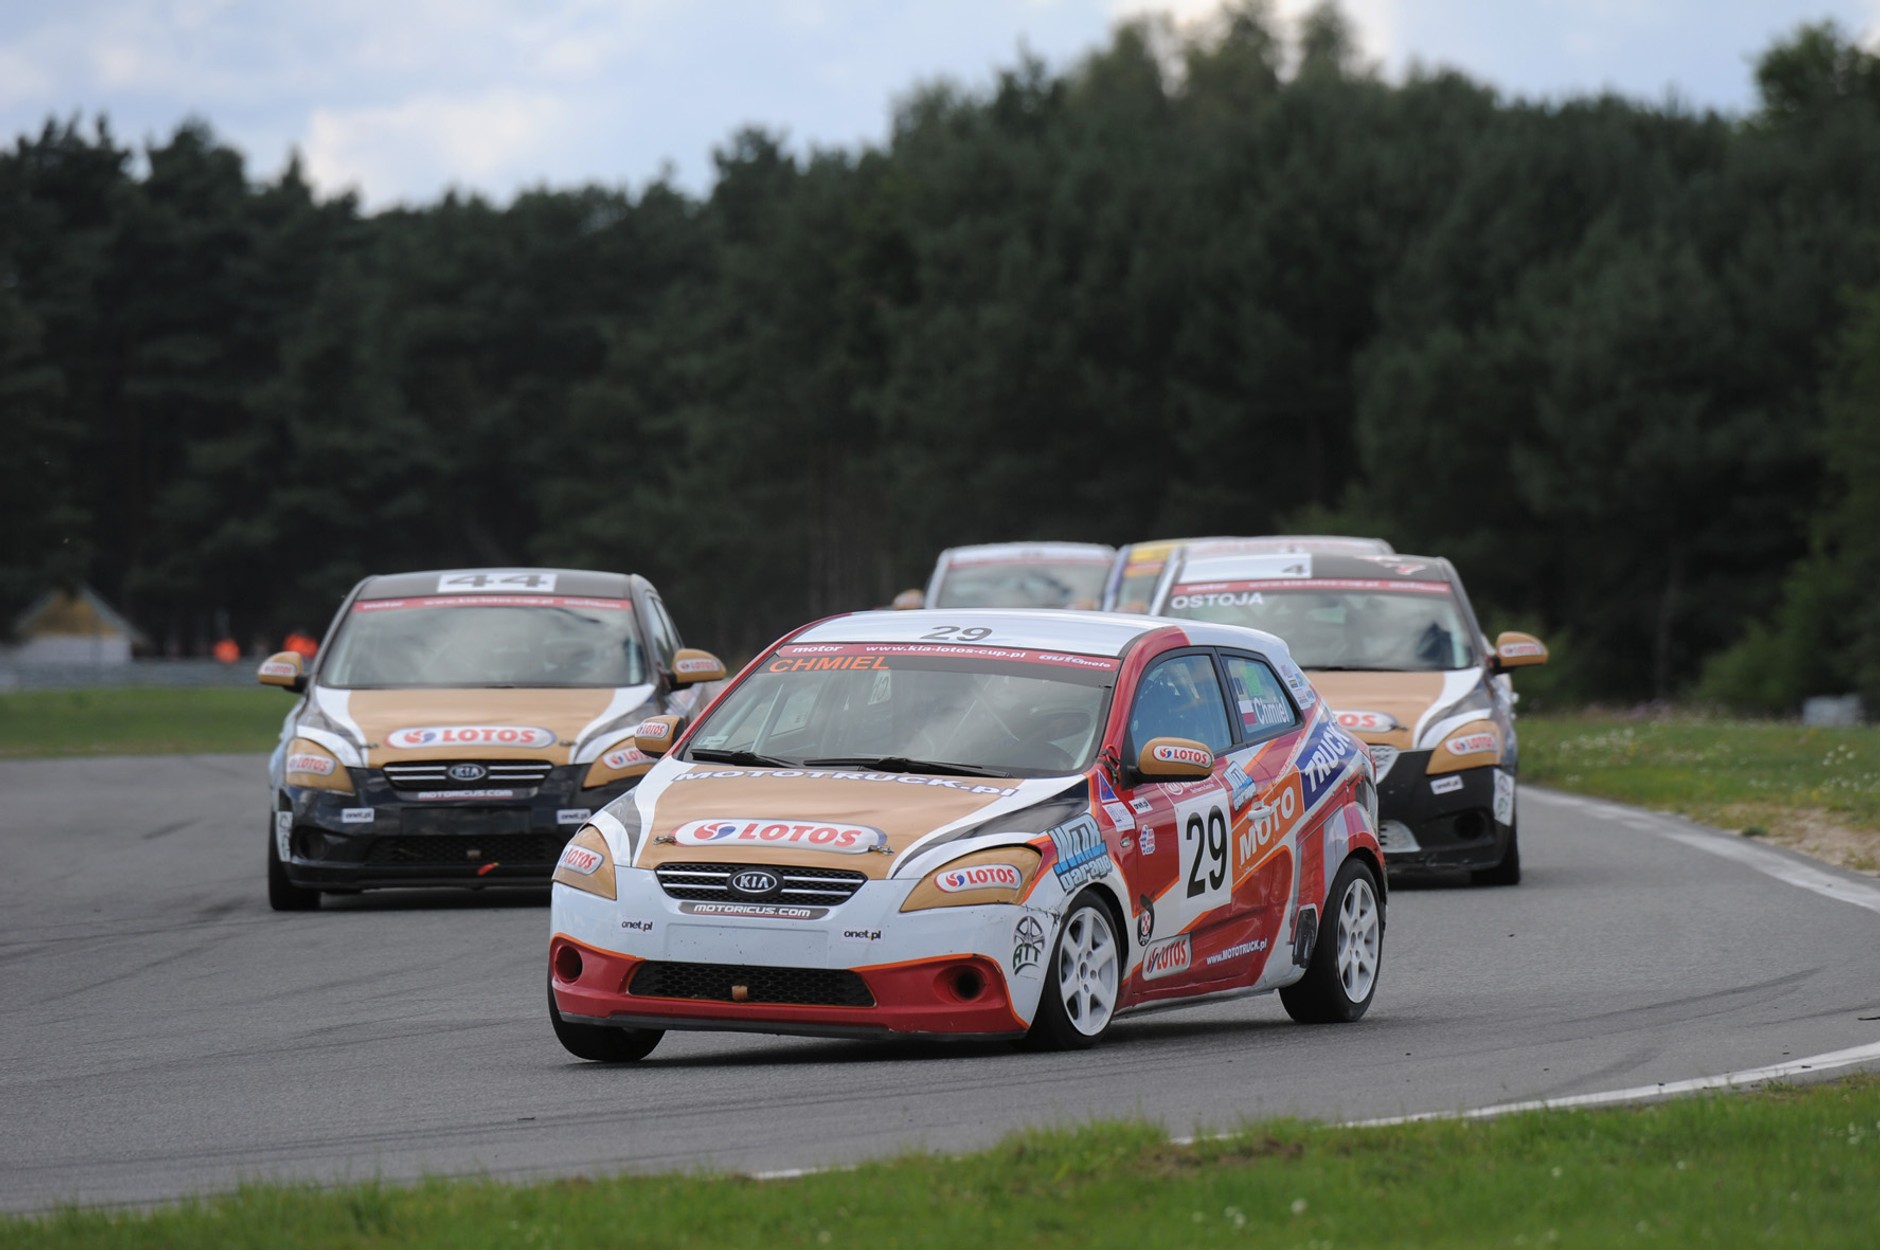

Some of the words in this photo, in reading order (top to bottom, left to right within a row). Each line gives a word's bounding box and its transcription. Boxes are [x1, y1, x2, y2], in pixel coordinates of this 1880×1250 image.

[1281, 565, 1307, 577] 4
[446, 574, 549, 588] 44
[1171, 590, 1265, 610] OSTOJA
[919, 625, 994, 643] 29
[792, 644, 844, 654] motor
[866, 644, 1027, 659] www.kia-lotos-cup.pl
[768, 655, 890, 673] CHMIEL
[1253, 695, 1291, 726] Chmiel
[442, 728, 536, 744] LOTOS
[641, 723, 666, 736] LOTOS
[296, 757, 330, 773] LOTOS
[1173, 748, 1208, 765] LOTOS
[455, 767, 481, 778] KIA
[672, 768, 1021, 798] MOTOTRUCK.pl
[1239, 786, 1295, 866] MOTO
[1304, 719, 1351, 793] TRUCK
[737, 822, 863, 848] LOTOS
[565, 849, 597, 869] LOTOS
[1186, 804, 1228, 899] 29
[738, 874, 770, 889] KIA
[968, 867, 1016, 886] LOTOS
[1058, 854, 1113, 894] garage
[693, 903, 811, 918] MOTORICUS.COM
[621, 920, 653, 932] onet.pl
[843, 929, 882, 941] onet.pl
[1156, 939, 1188, 971] LOTOS
[1206, 938, 1268, 966] www.MOTOTRUCK.pl
